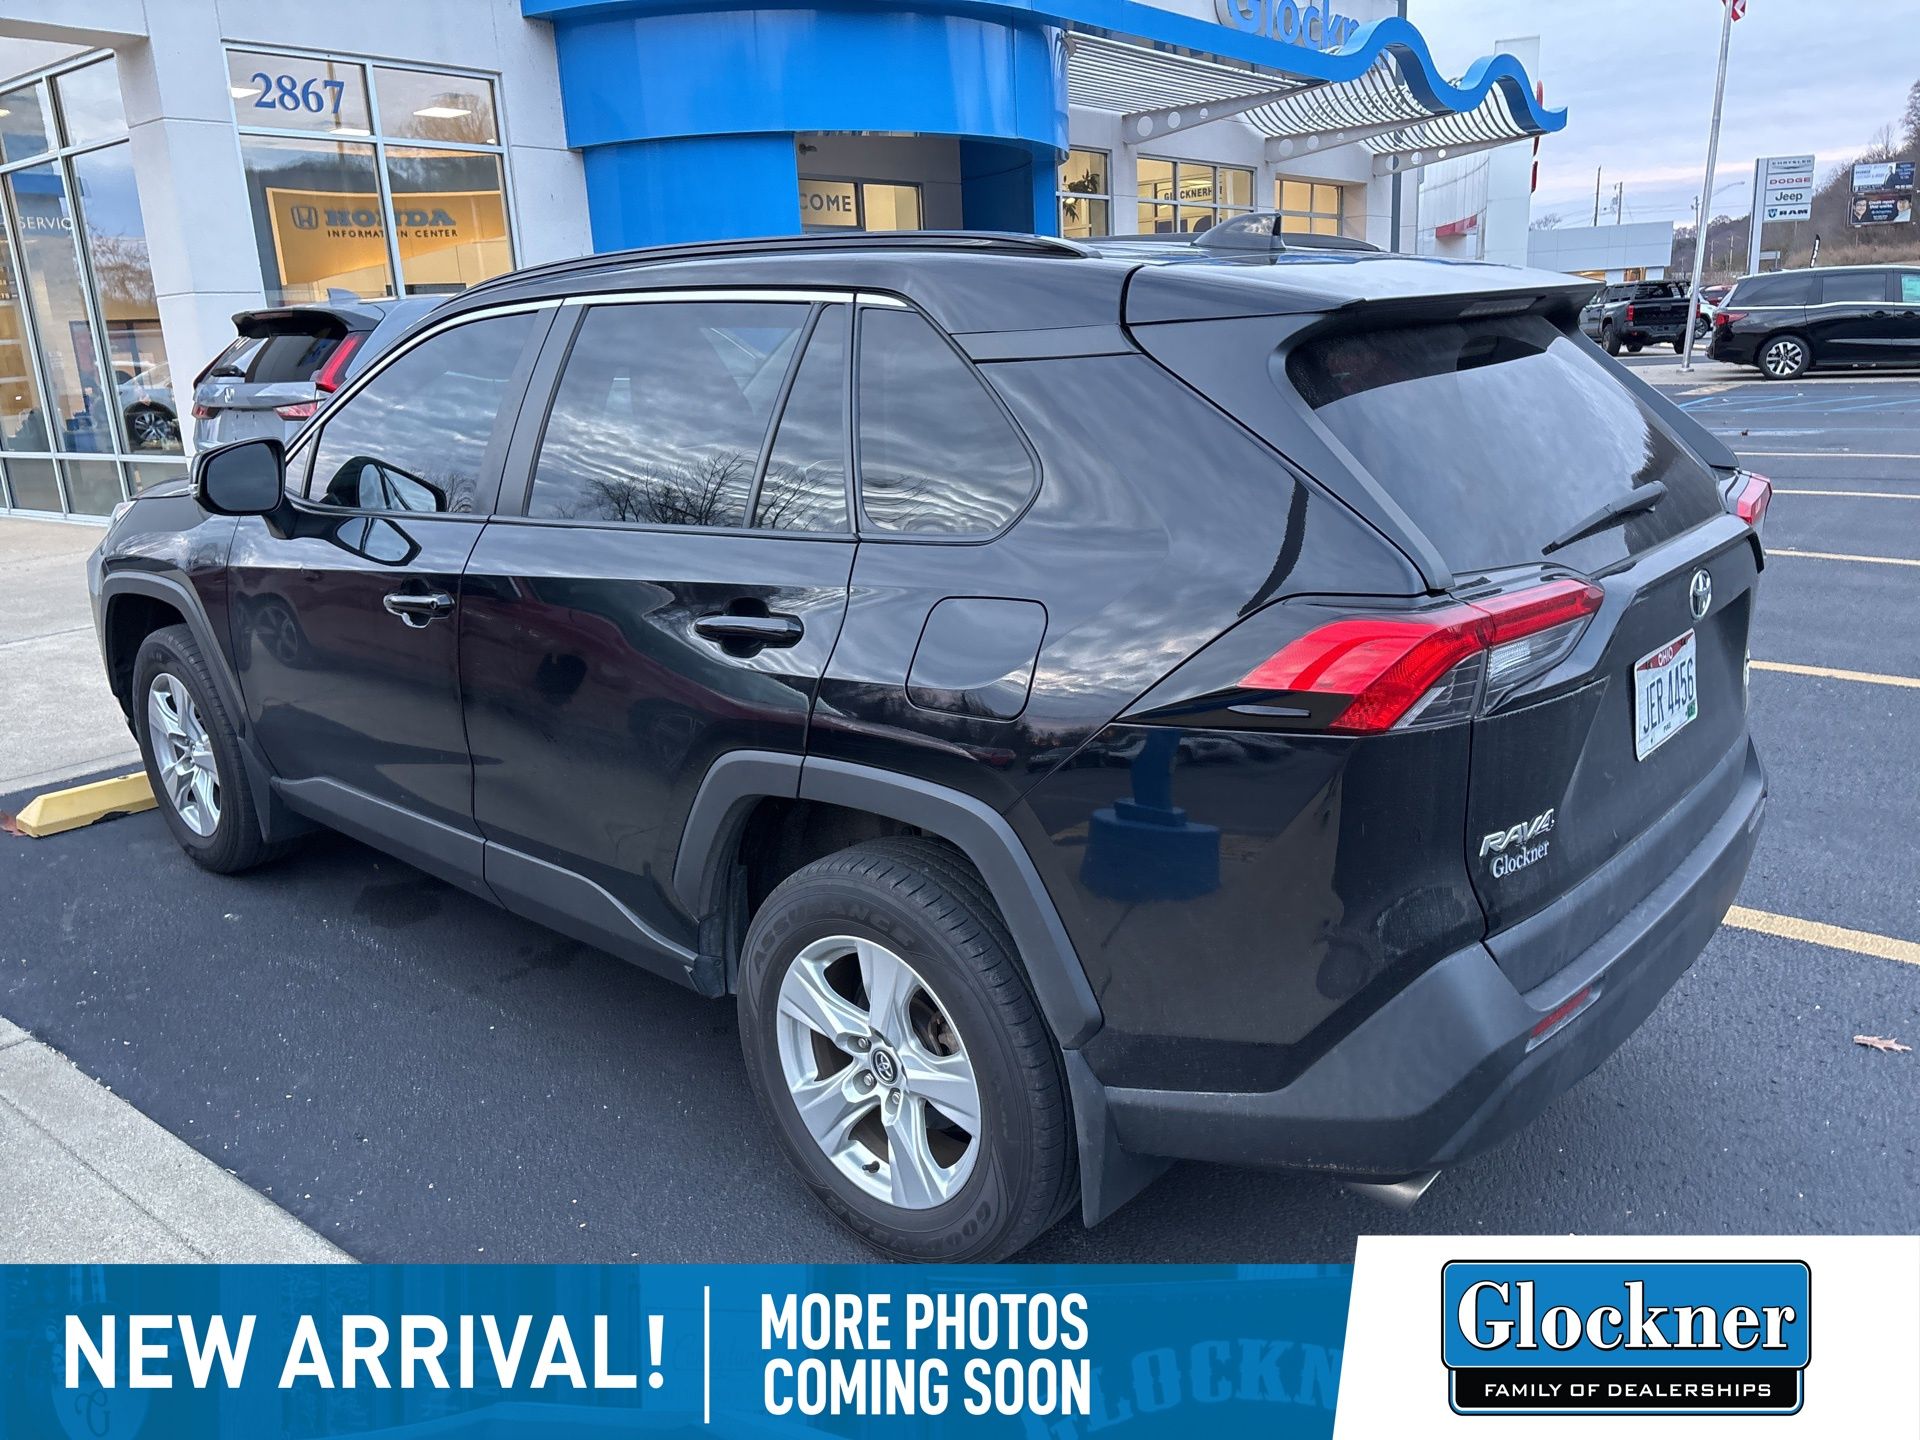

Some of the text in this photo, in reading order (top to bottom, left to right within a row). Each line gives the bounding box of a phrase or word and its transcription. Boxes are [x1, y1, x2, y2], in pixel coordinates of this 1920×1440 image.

[250, 72, 345, 114] 2867
[1769, 177, 1811, 185] DODGE
[1775, 191, 1803, 202] Jeep
[1779, 208, 1808, 216] RAM
[327, 229, 458, 239] INFORMATN CENTER
[1658, 647, 1674, 667] OHIO
[1643, 657, 1694, 735] JER 4456
[1479, 808, 1555, 857] RAV4
[1491, 840, 1550, 879] Glockner
